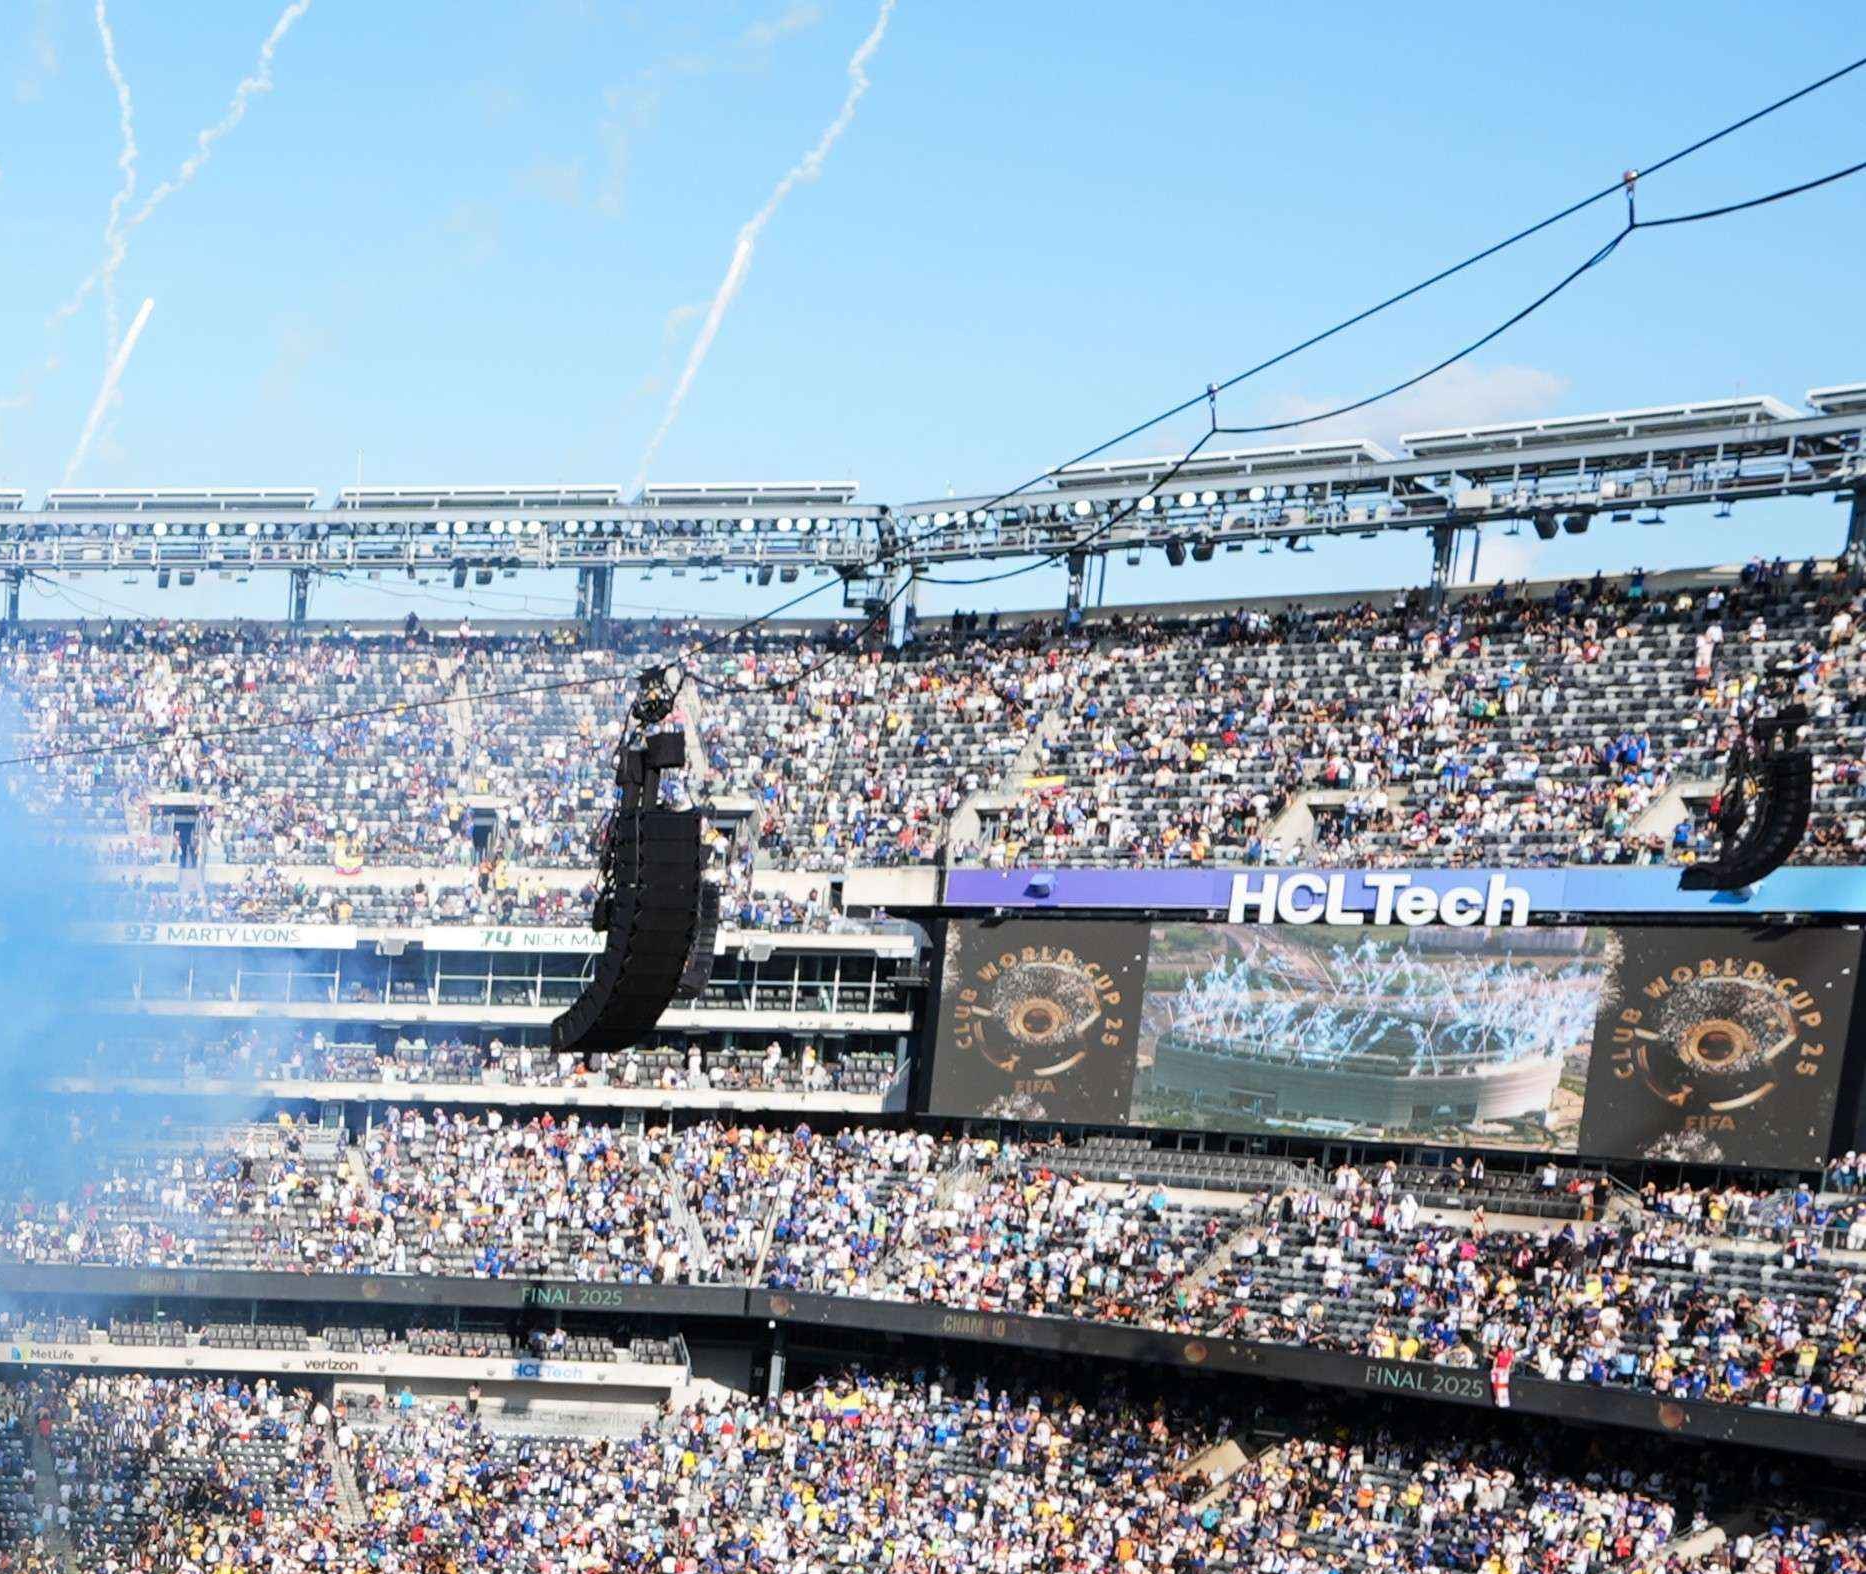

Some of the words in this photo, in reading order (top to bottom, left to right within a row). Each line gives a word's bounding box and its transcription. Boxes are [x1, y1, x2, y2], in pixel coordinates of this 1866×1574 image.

[1228, 873, 1530, 926] HCLTech
[123, 925, 158, 942] 93
[166, 927, 238, 943] MARTY
[241, 928, 301, 944] LYONS
[479, 930, 512, 947] 74
[523, 932, 566, 947] NICK
[976, 945, 1075, 981] WORLD
[1642, 957, 1766, 999] WORLD
[1085, 962, 1122, 1005] CUP
[1775, 977, 1823, 1027] CUP
[954, 988, 978, 1050] CLUB
[1101, 1018, 1124, 1047] 25
[1612, 1007, 1643, 1079] CLUB
[1795, 1042, 1827, 1076] 25
[1684, 1114, 1737, 1131] FIFA
[520, 1287, 575, 1304] FINAL
[579, 1289, 623, 1306] 2025
[29, 1348, 75, 1360] MetLife
[304, 1357, 359, 1371] verizon
[511, 1362, 584, 1378] HCLTech
[1364, 1365, 1428, 1391] FINAL
[1432, 1373, 1484, 1398] 2025
